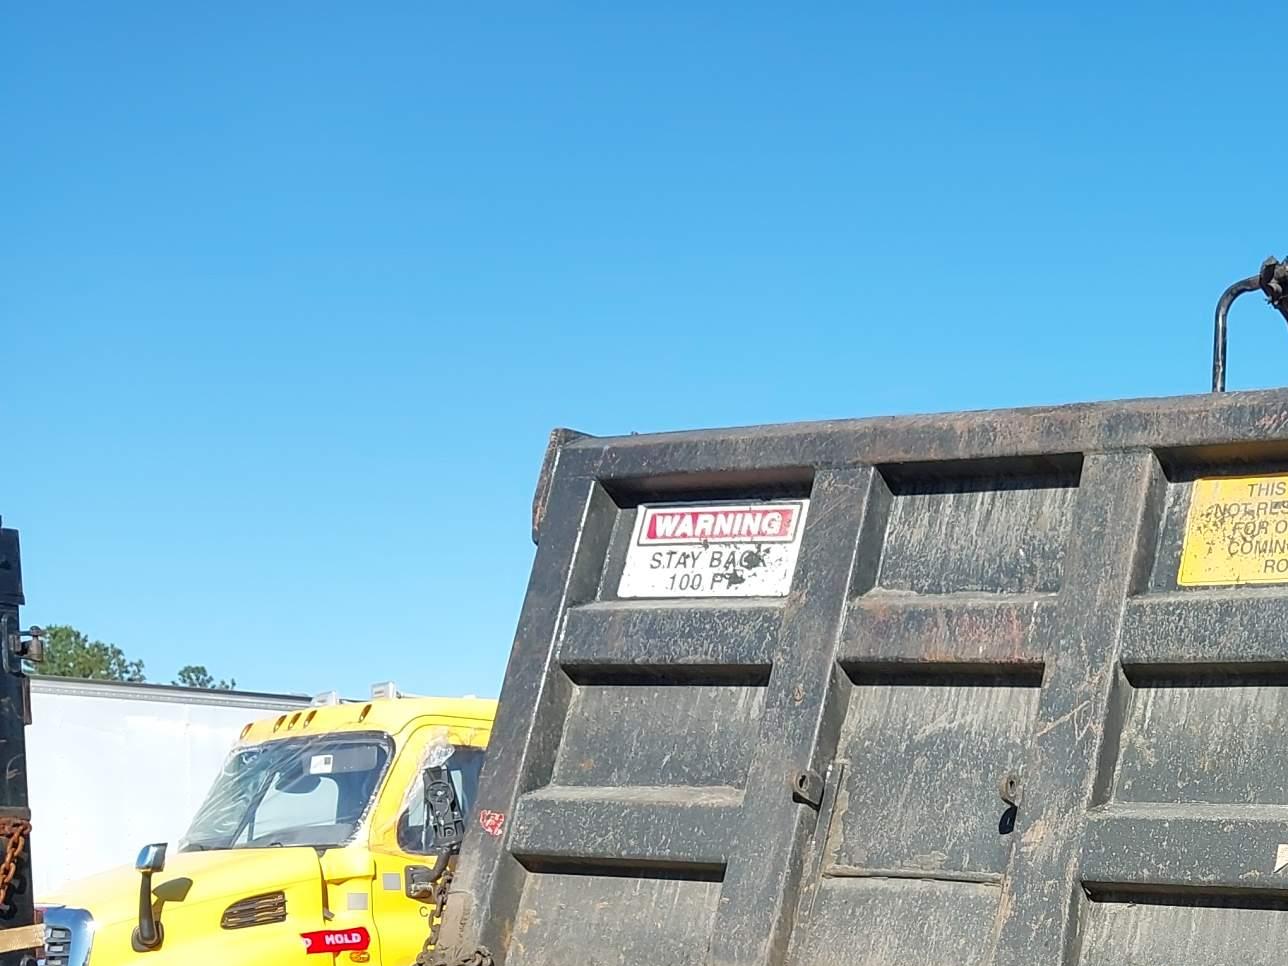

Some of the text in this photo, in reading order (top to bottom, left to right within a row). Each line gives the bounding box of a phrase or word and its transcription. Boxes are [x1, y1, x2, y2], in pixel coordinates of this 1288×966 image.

[1247, 481, 1287, 497] THIS
[1214, 502, 1253, 517] NOT
[656, 512, 781, 538] WARNING
[1232, 520, 1269, 536] FOR
[650, 551, 702, 569] STAY
[668, 573, 702, 590] 100
[324, 932, 362, 945] HOLD
